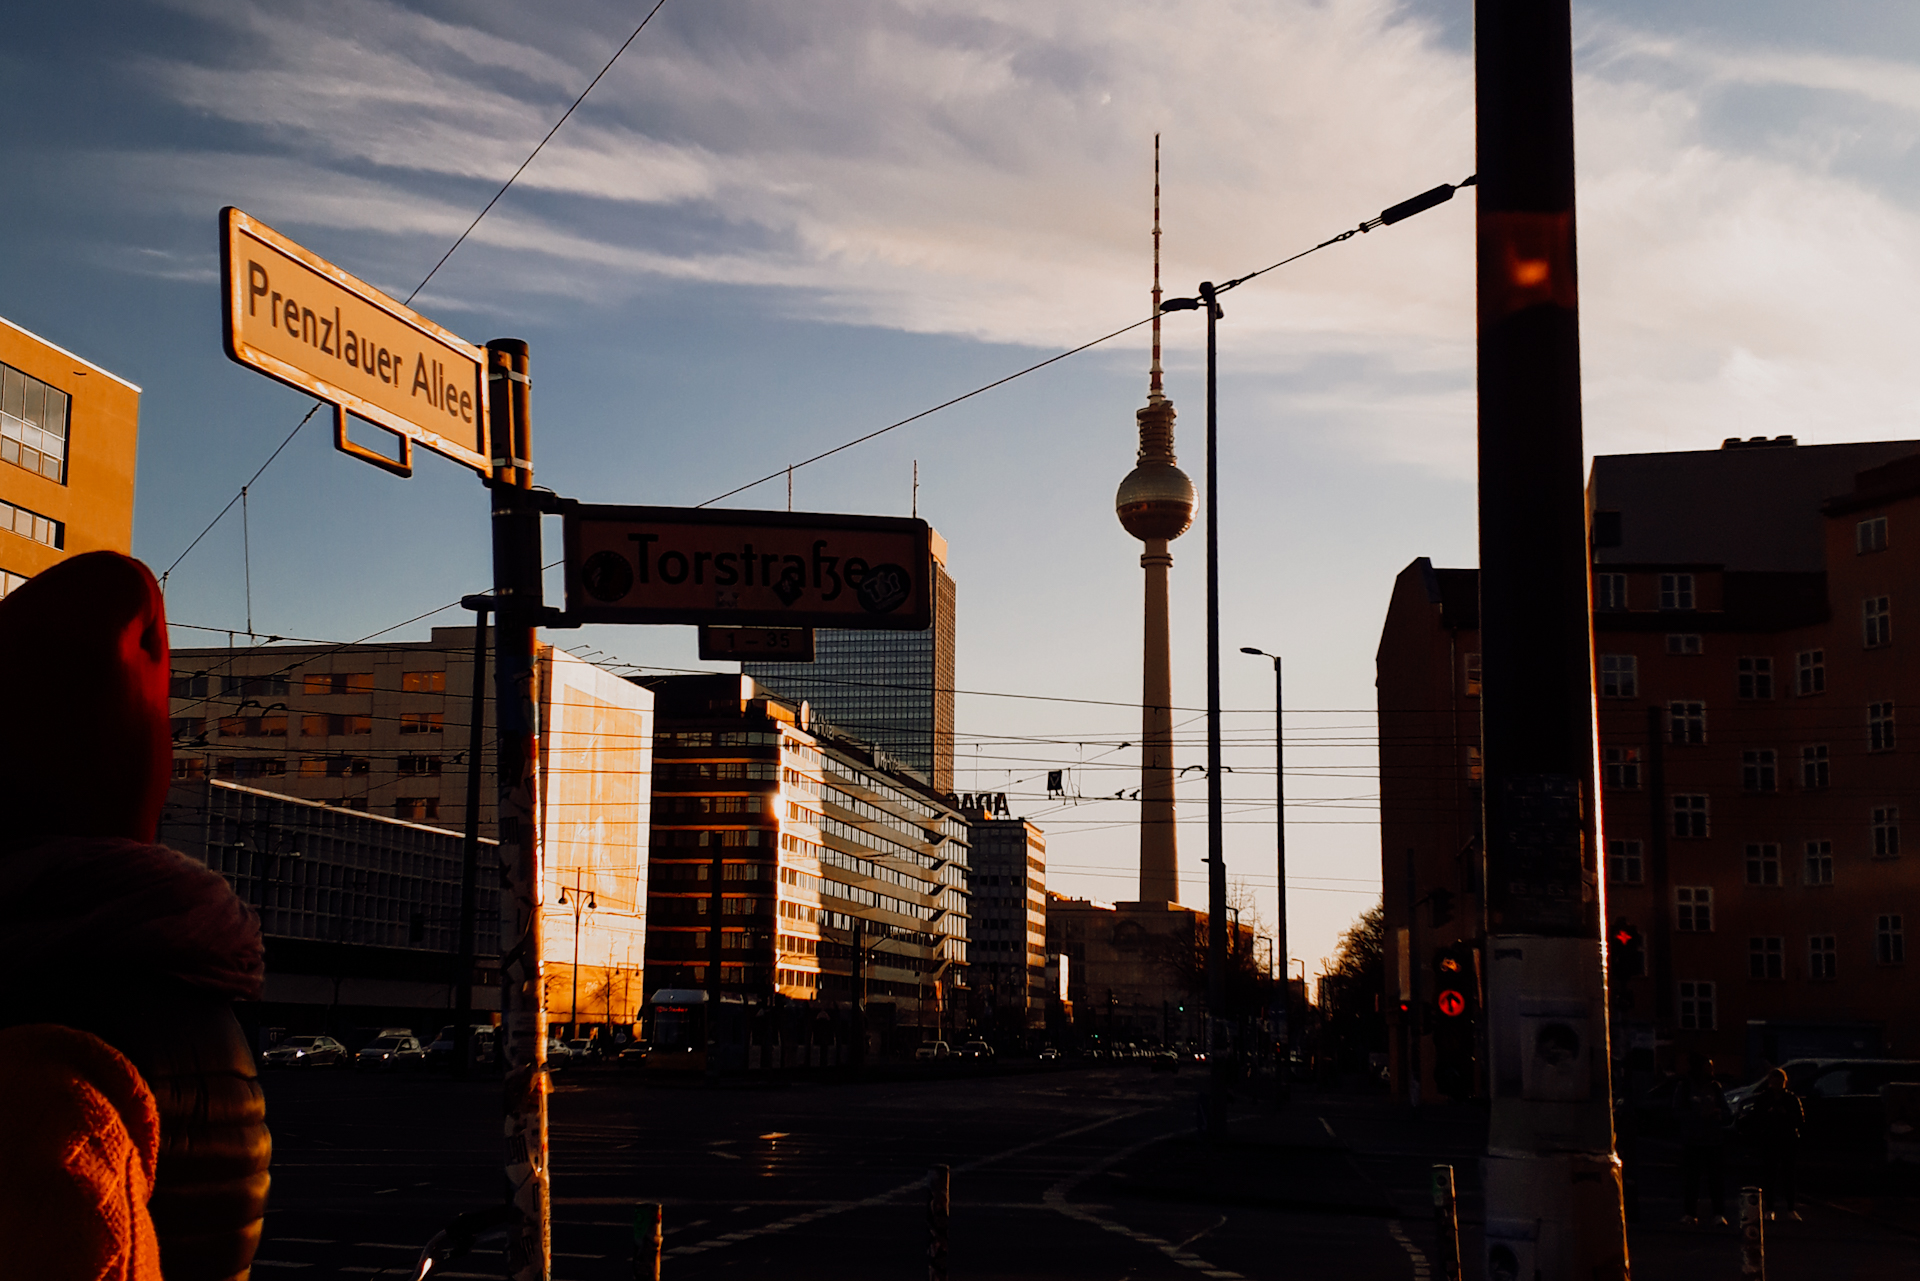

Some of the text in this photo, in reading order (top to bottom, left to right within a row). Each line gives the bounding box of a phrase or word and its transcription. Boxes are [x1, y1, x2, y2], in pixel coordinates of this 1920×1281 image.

[248, 259, 473, 424] Prenzlauer Allee
[627, 532, 870, 601] Torstraße
[726, 632, 735, 649] 1
[766, 632, 790, 649] 35
